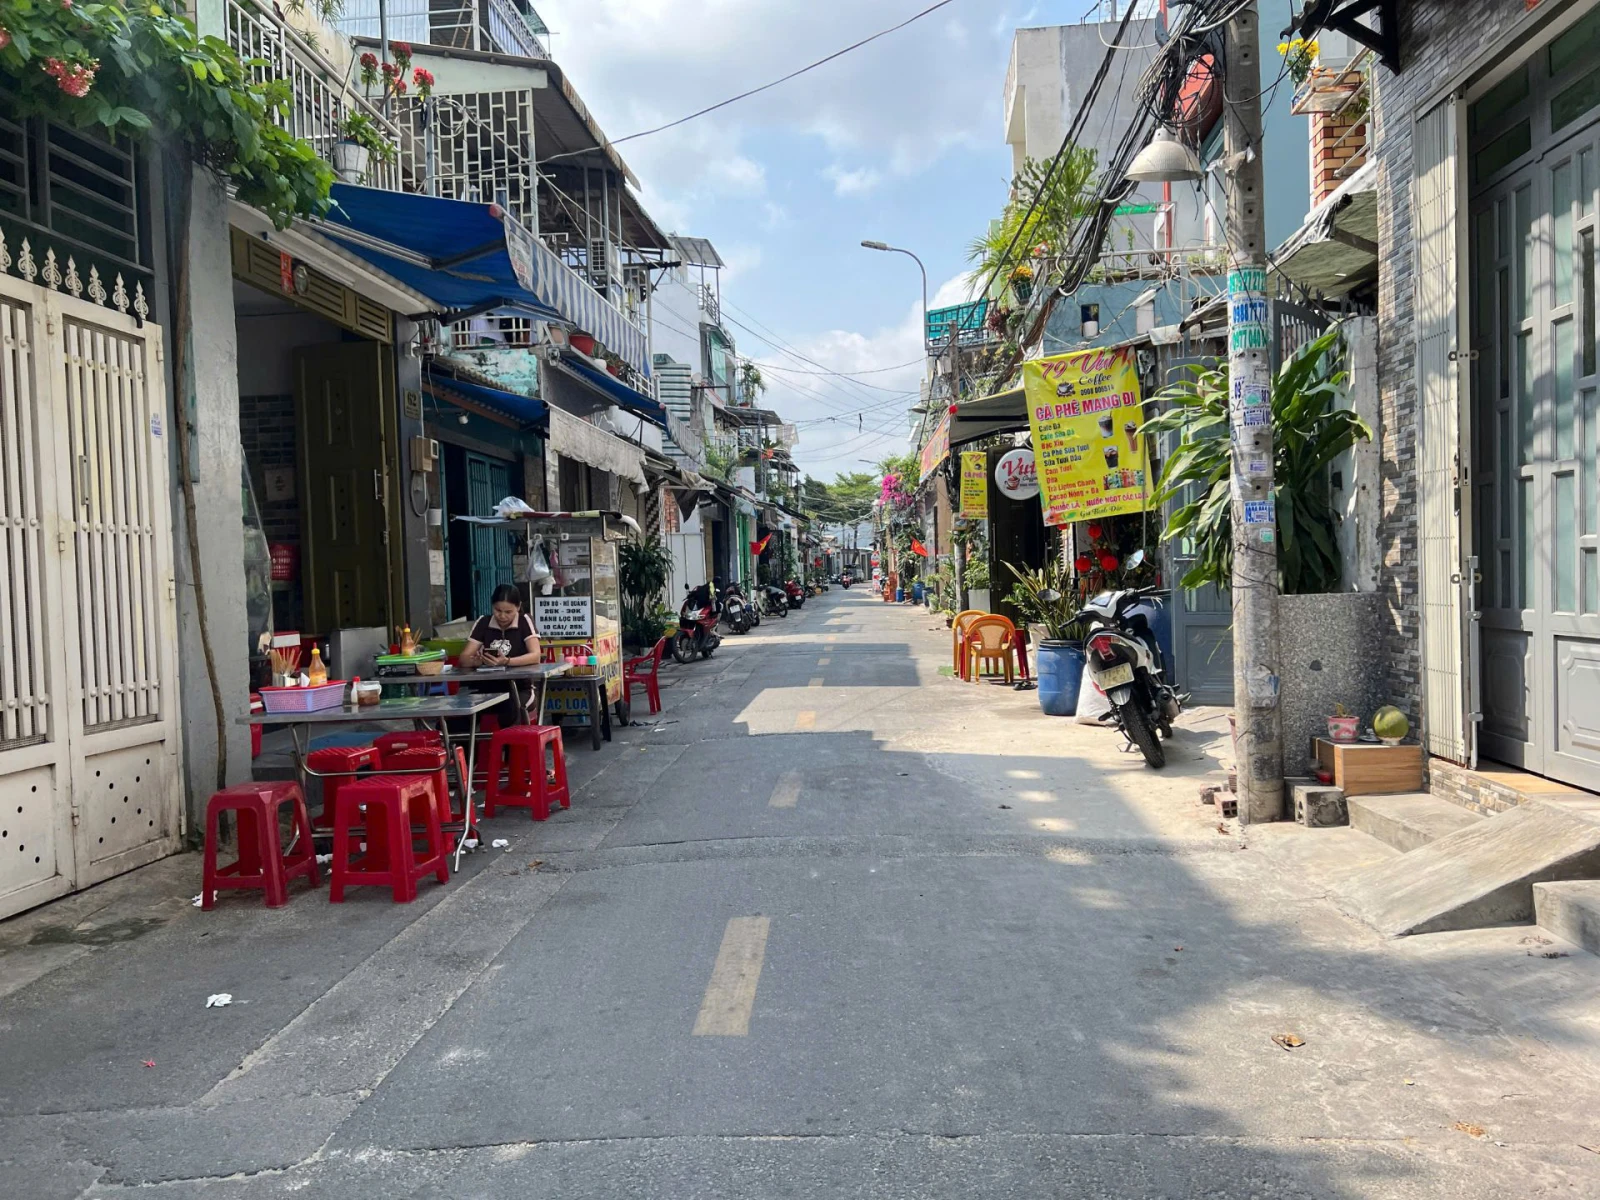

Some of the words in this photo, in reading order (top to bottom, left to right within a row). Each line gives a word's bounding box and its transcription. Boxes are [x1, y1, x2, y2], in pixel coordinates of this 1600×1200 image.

[1079, 374, 1112, 386] Coffee
[407, 391, 417, 407] 62
[1055, 400, 1080, 417] PHÊ
[1082, 393, 1121, 413] MANG
[1122, 390, 1137, 406] ĐI
